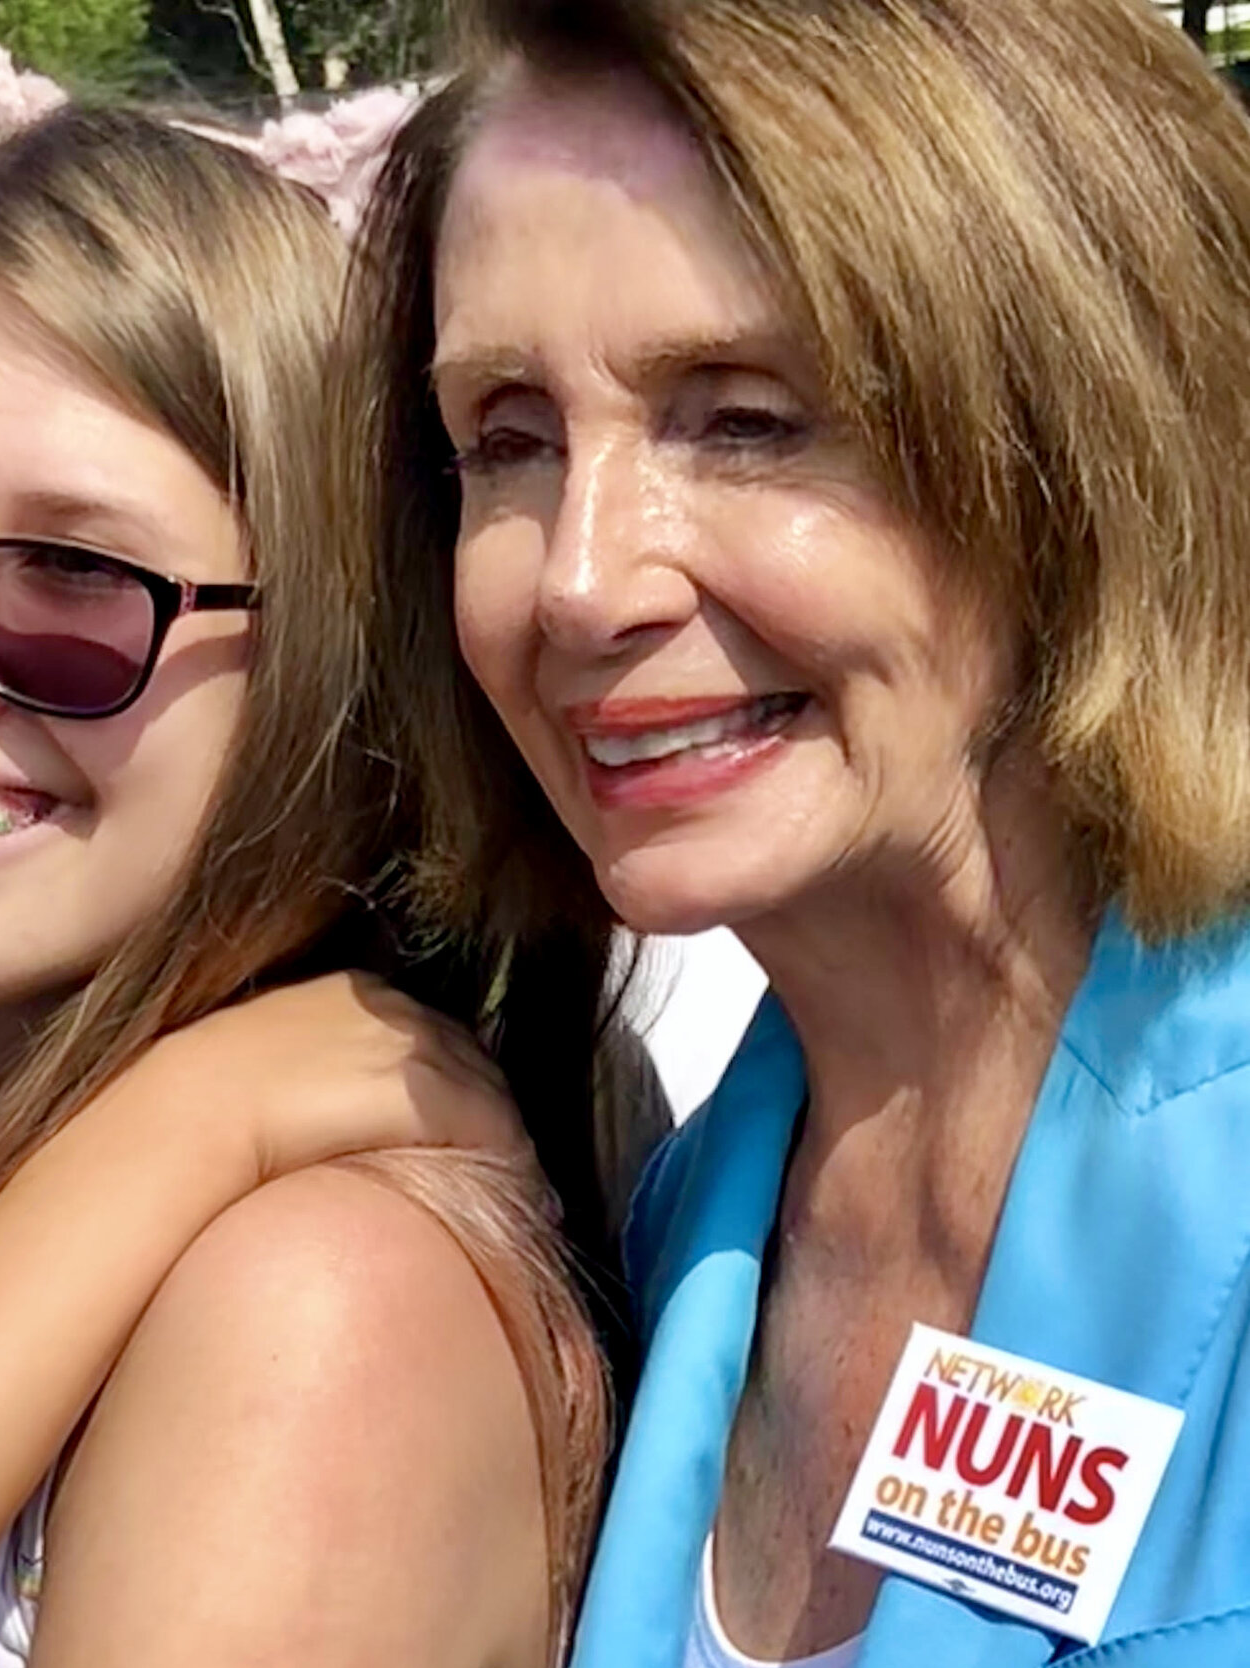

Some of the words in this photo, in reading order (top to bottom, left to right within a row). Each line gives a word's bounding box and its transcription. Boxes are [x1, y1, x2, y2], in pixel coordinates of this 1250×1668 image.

[891, 1380, 1131, 1526] NUNS
[864, 1516, 1073, 1611] www.nunsonthebus.org
[876, 1475, 929, 1519] on
[936, 1489, 1006, 1546] the
[1011, 1511, 1091, 1578] bus
